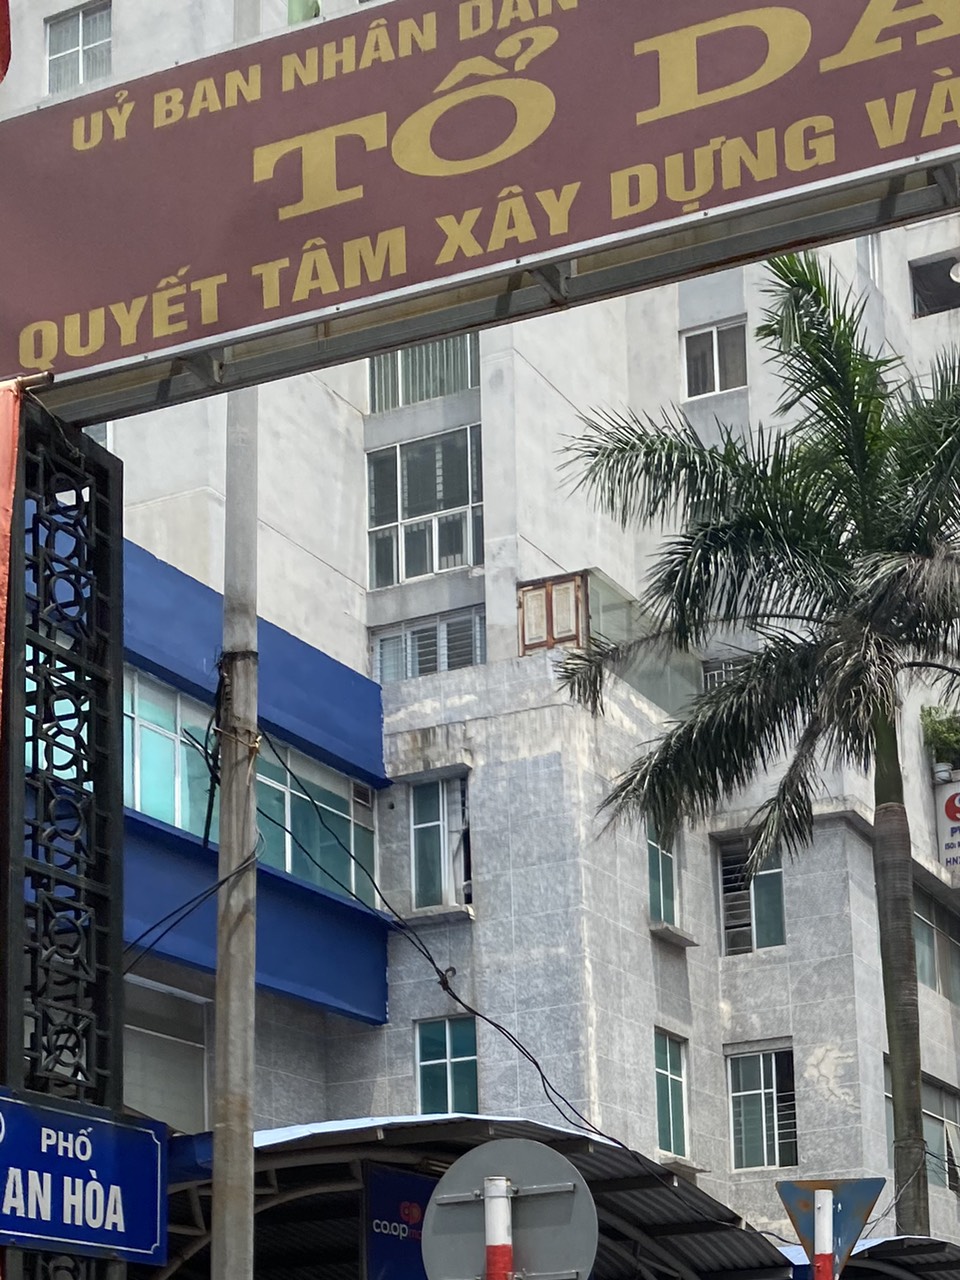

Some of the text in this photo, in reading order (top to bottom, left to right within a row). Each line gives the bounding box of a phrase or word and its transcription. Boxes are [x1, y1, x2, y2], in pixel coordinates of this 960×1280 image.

[71, 90, 132, 152] UỶ
[153, 65, 261, 129] BAN
[281, 18, 437, 92] NHÂN
[252, 26, 559, 221] TỔ
[18, 263, 226, 371] QUYẾT
[260, 227, 407, 310] TÂM
[435, 182, 580, 265] XÂY
[610, 115, 836, 220] DỰNG
[2, 1166, 125, 1232] AN HÒA
[41, 1126, 93, 1161] PHỐ
